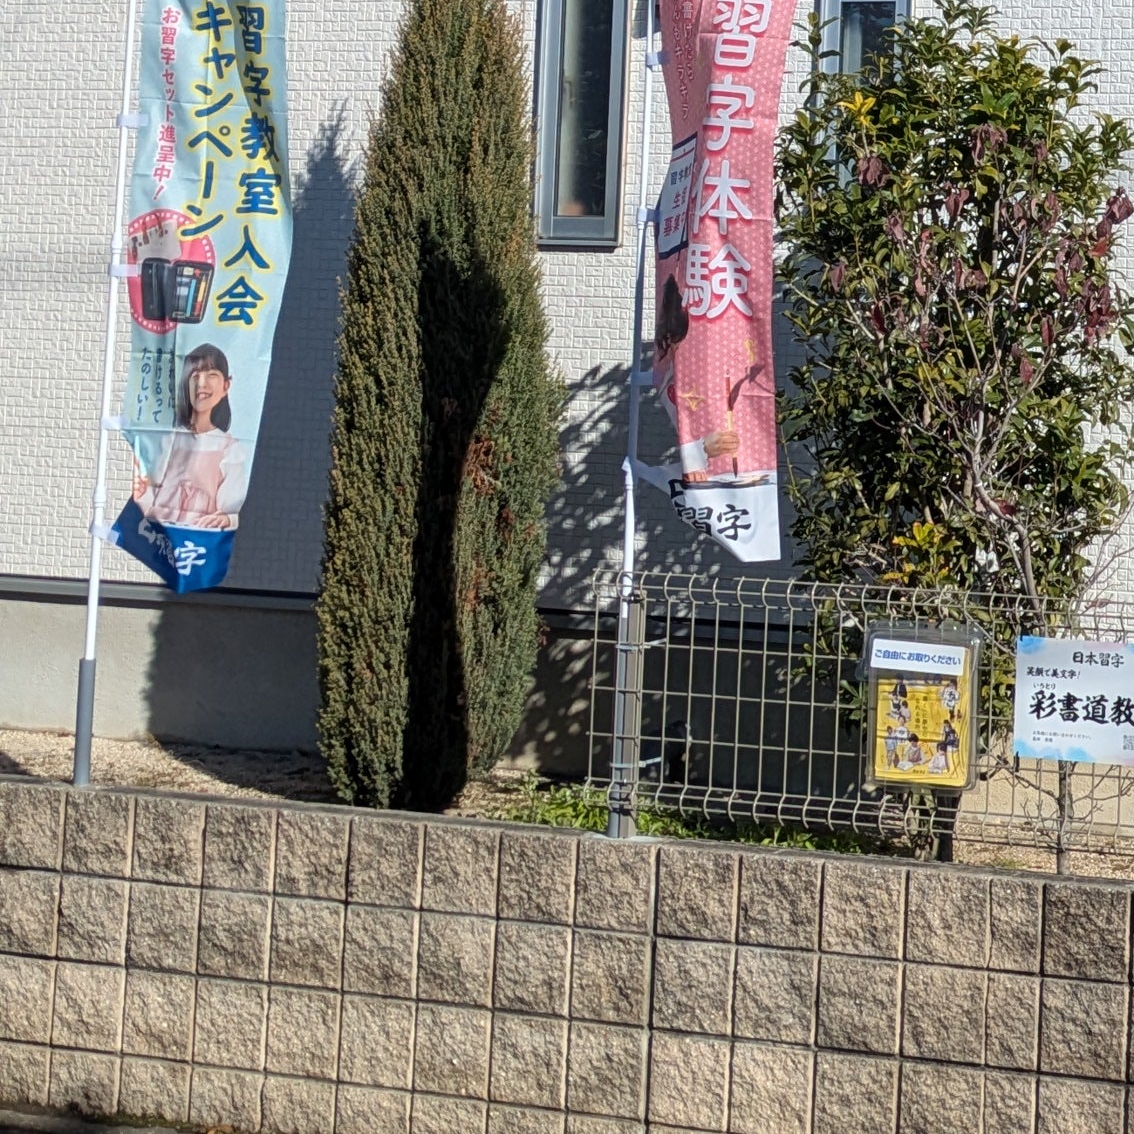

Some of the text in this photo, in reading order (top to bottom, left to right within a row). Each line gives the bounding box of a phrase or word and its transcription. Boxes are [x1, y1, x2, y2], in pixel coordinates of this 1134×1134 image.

[152, 6, 181, 201] お習字セット進呈中!
[180, 1, 236, 237] キャンペーン
[216, 4, 282, 325] 習字教室入会
[874, 649, 961, 666] ご自由にお取りください
[1072, 651, 1124, 669] 日本習字
